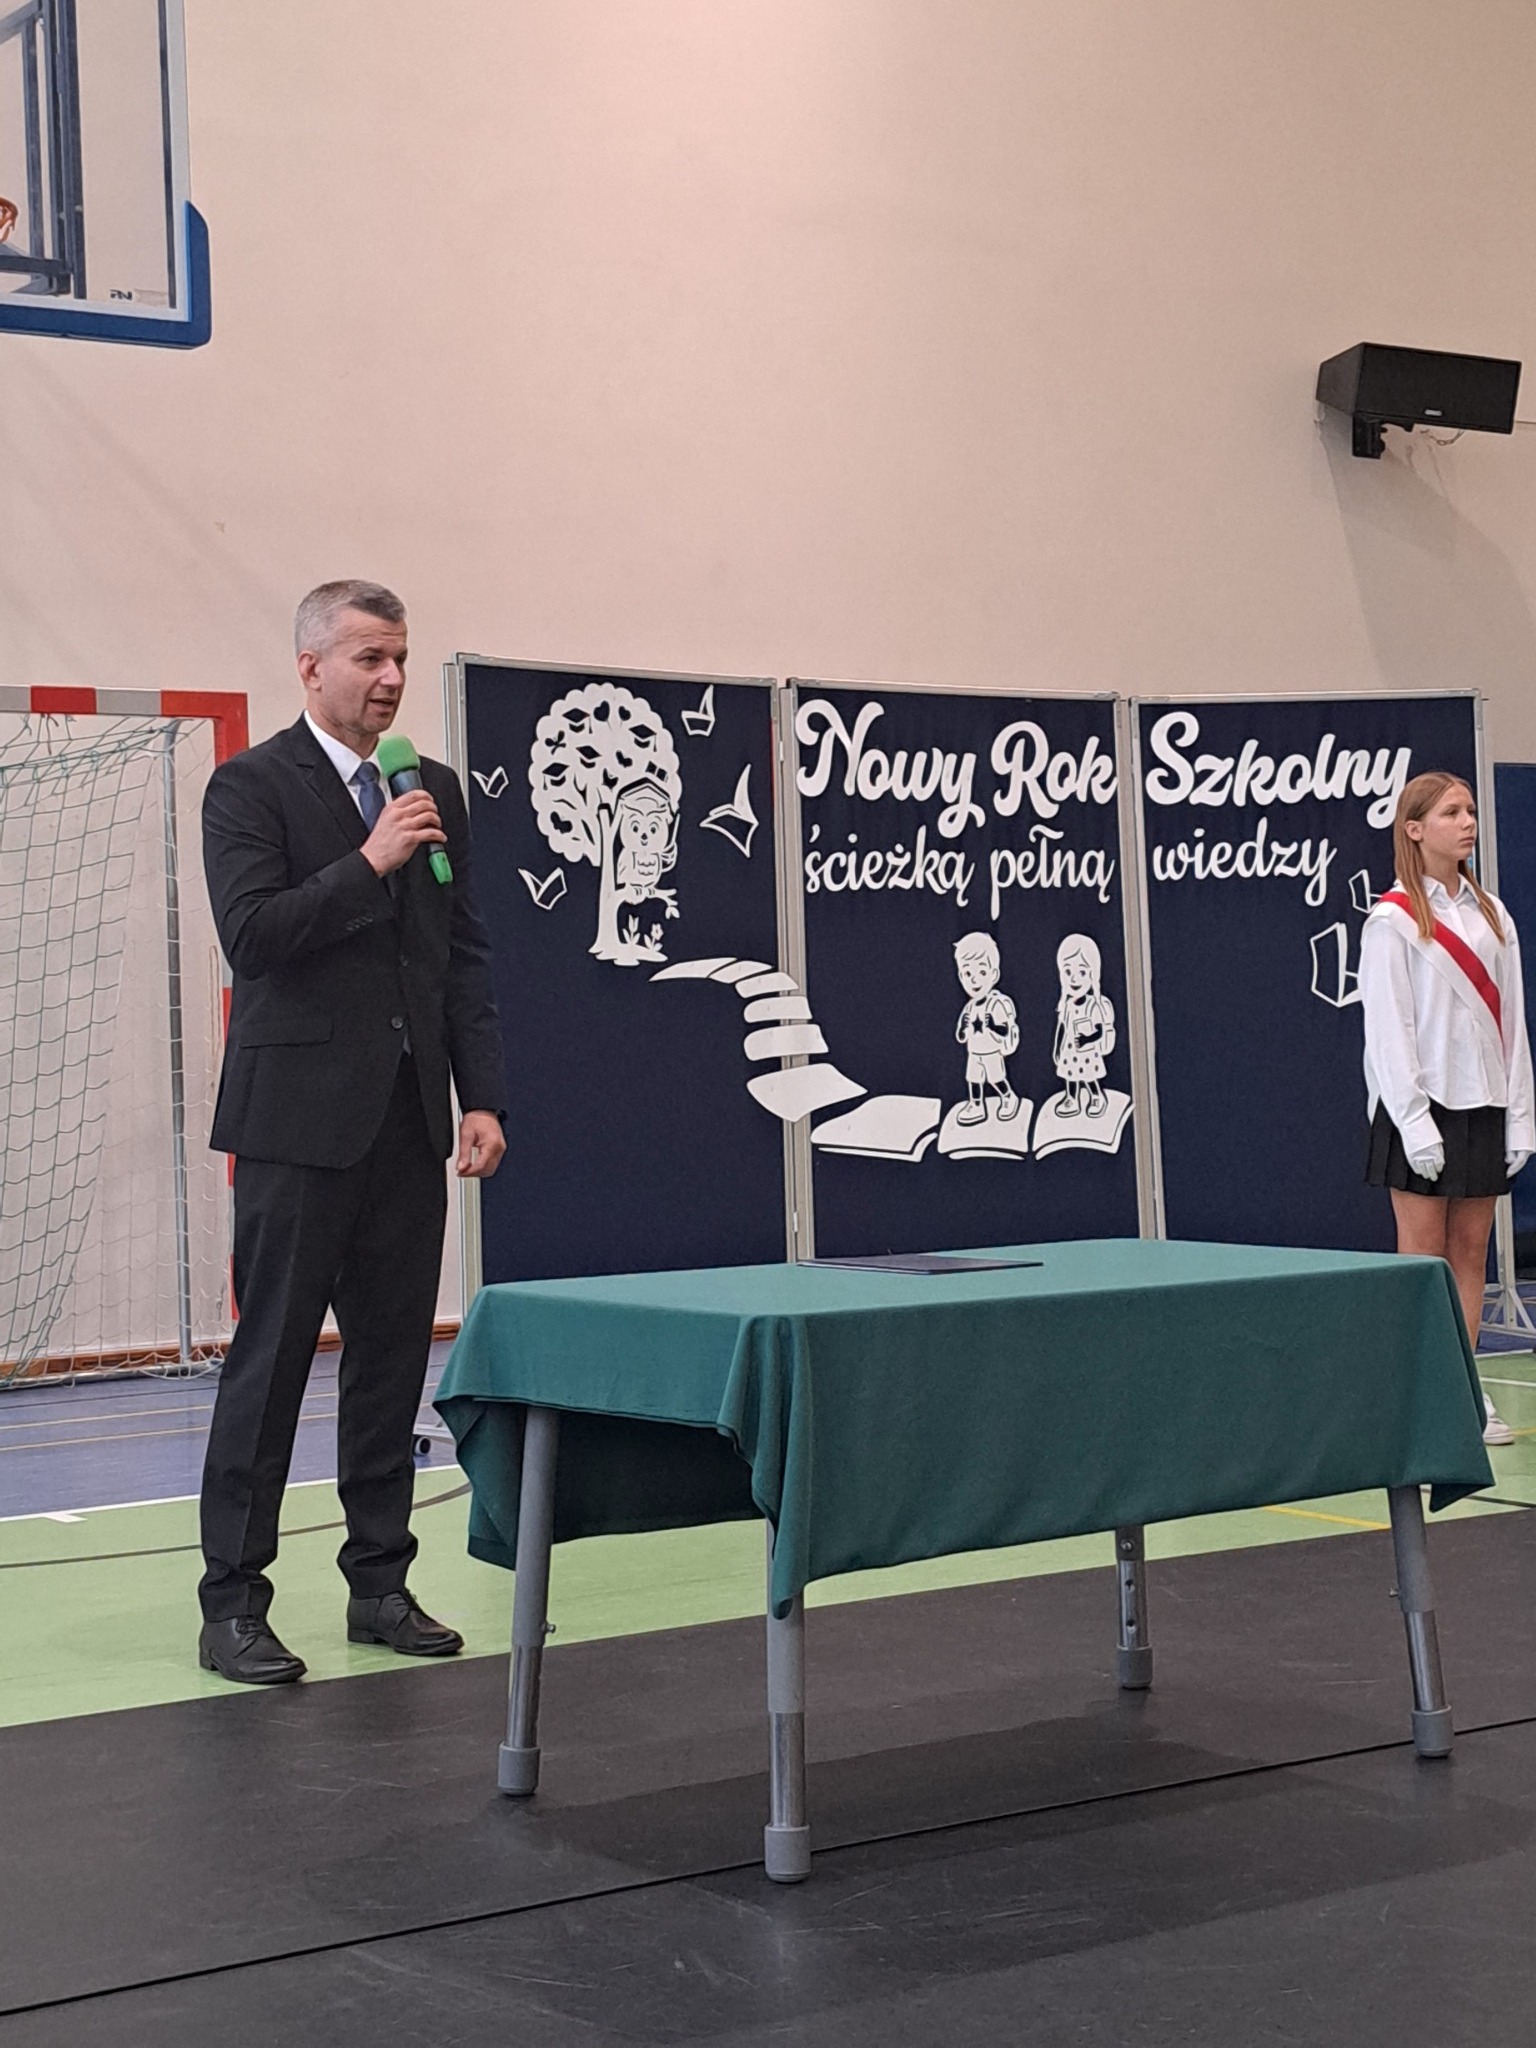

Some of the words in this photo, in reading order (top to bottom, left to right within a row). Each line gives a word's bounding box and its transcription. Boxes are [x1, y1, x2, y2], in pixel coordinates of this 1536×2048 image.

[795, 699, 985, 838] Nowy
[990, 721, 1117, 818] Rok
[1145, 711, 1412, 829] Szkolny
[804, 824, 975, 907] ścieżką
[990, 824, 1115, 921] pełną
[1152, 816, 1338, 907] wiedzy
